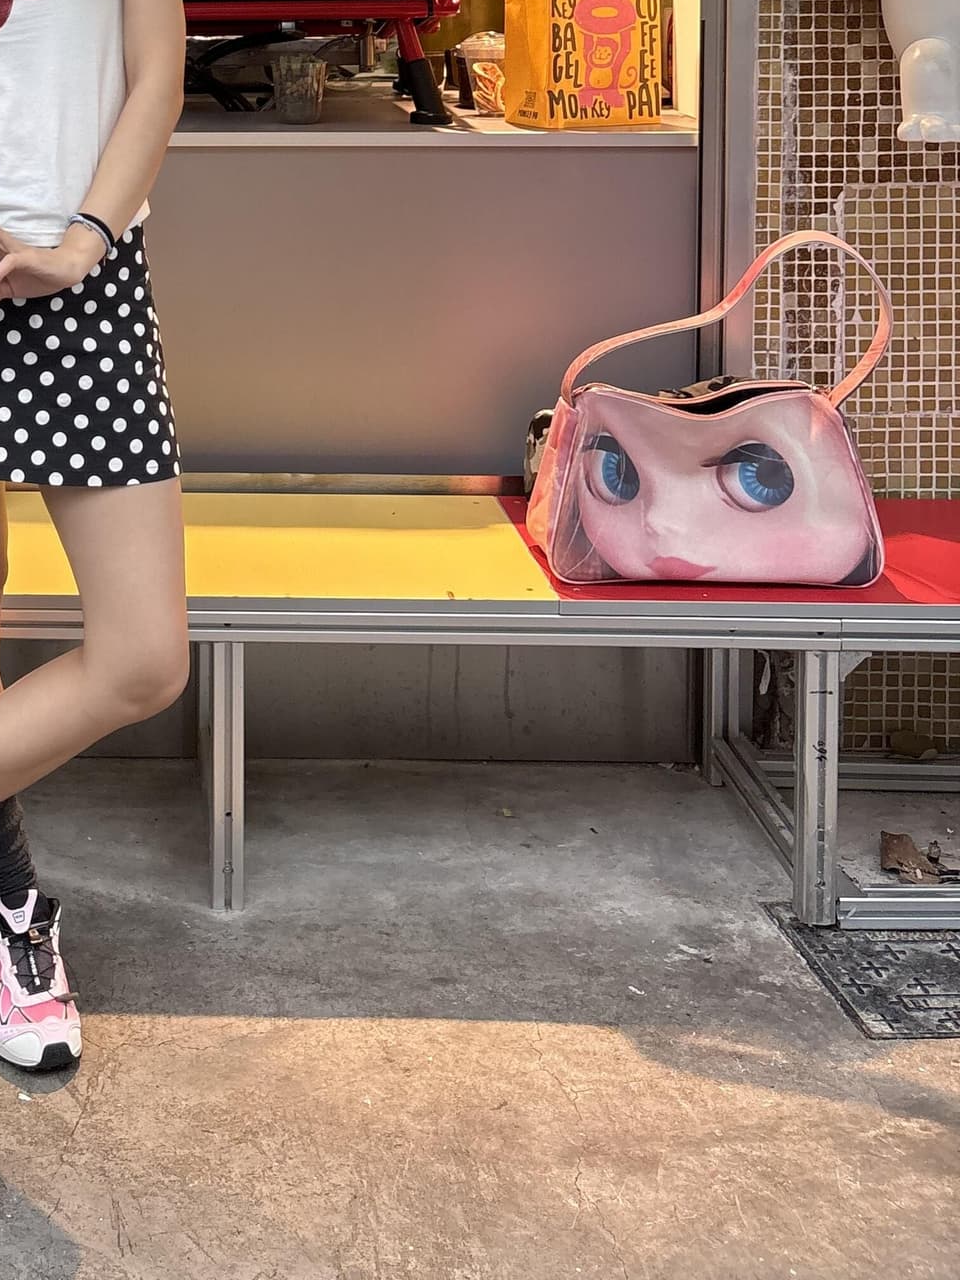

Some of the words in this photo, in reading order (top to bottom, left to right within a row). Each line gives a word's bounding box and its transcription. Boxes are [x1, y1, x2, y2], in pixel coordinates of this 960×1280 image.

[552, 22, 576, 52] BA
[553, 52, 582, 88] GEL
[626, 82, 660, 119] PAI
